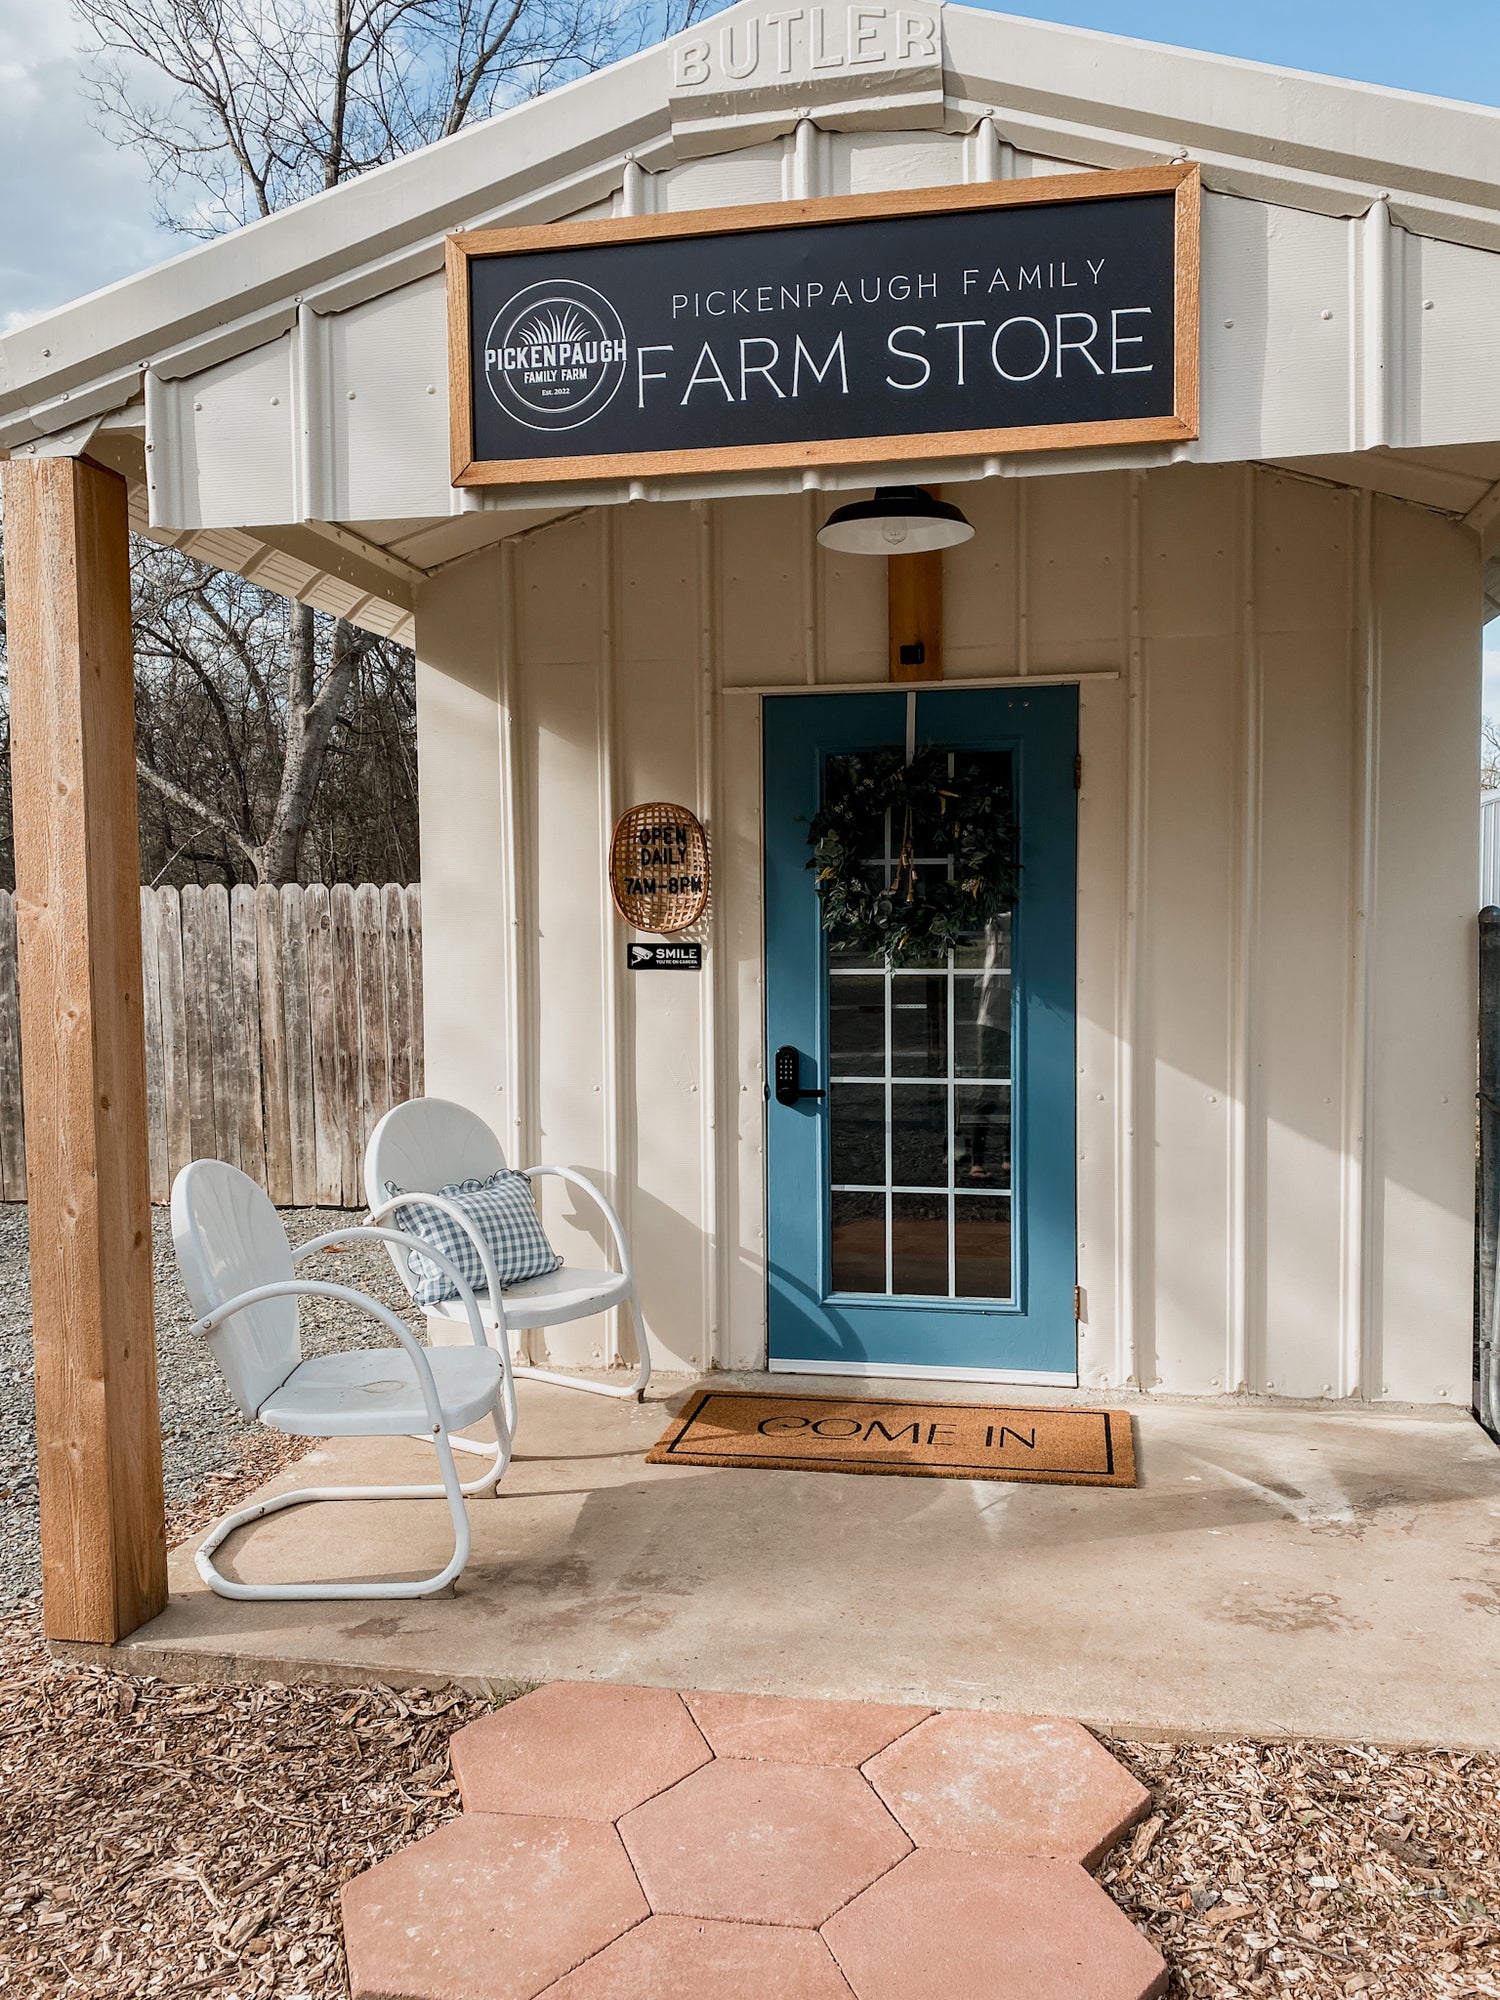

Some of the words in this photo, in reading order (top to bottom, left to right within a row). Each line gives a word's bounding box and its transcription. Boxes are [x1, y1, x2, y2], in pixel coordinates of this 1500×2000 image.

[673, 5, 935, 88] BUTLER
[672, 272, 937, 319] PICKENPAUGH
[963, 258, 1105, 295] FAMILY
[484, 338, 628, 372] PICKENPAUGH
[636, 330, 849, 408] FARM
[885, 306, 1154, 390] STORE
[524, 369, 558, 384] FAMILY
[561, 367, 588, 382] FARM
[554, 387, 570, 396] 2022
[639, 827, 687, 845] OPEN
[640, 847, 687, 866] DAILY
[655, 948, 698, 959] SMILE
[757, 1415, 955, 1447] COME
[984, 1424, 1036, 1449] IN
